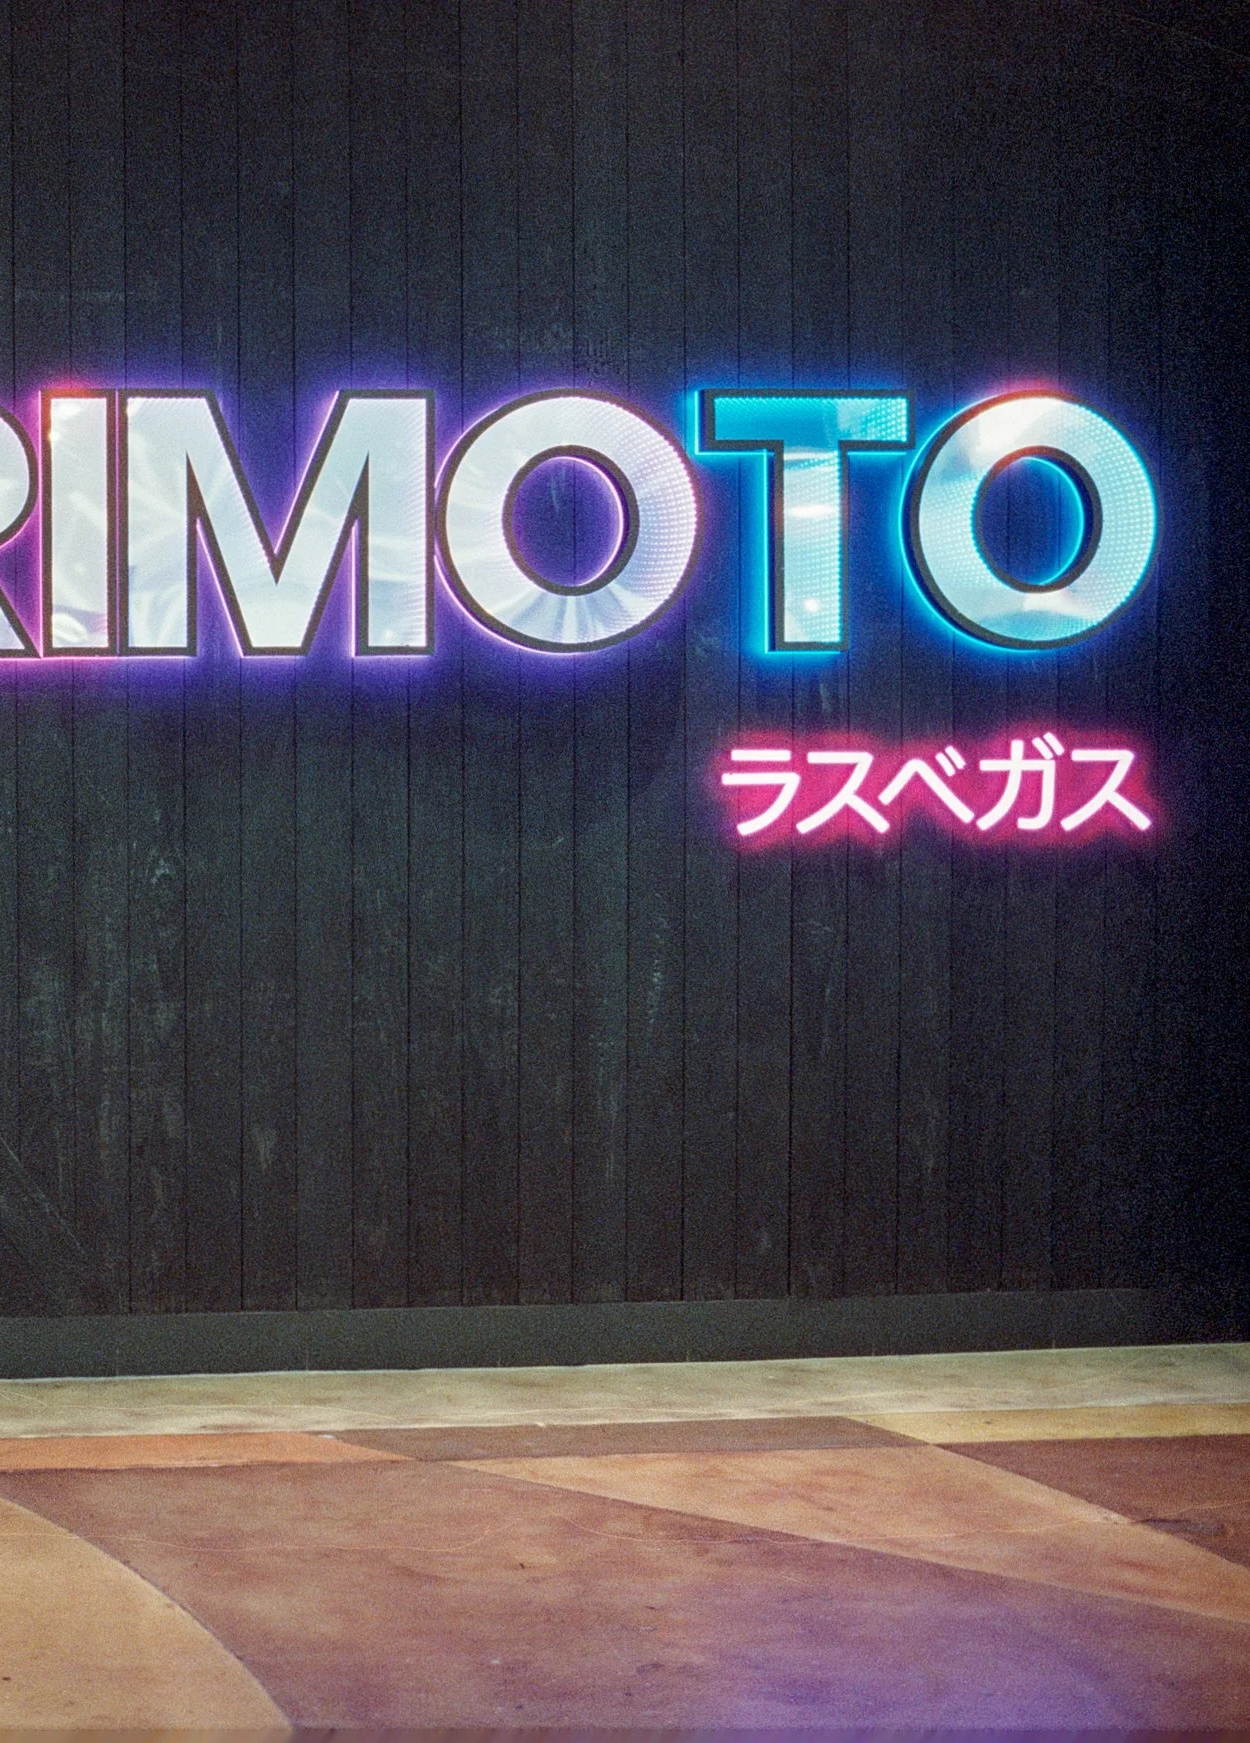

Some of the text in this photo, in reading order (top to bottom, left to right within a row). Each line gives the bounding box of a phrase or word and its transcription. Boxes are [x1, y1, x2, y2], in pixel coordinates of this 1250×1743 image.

[722, 733, 1152, 835] ラスベガス
